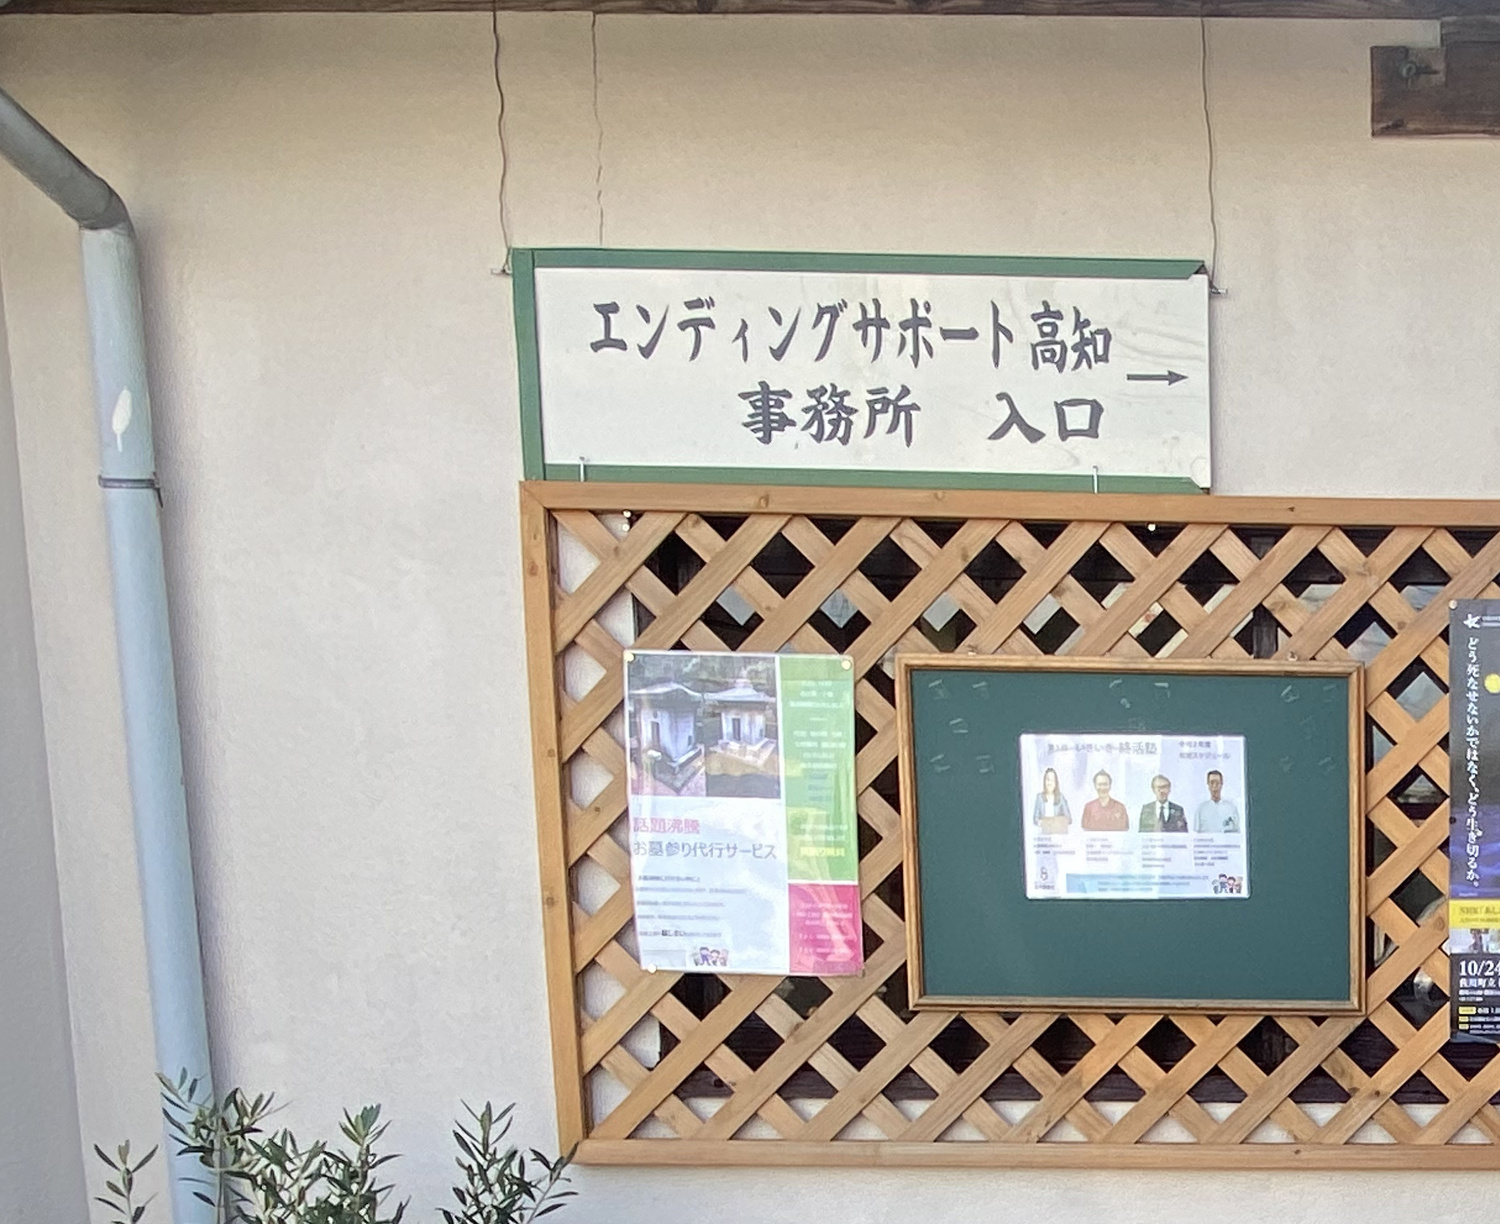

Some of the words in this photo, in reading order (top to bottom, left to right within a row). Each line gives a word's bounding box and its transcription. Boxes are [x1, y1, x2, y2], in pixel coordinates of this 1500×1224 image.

[589, 296, 1112, 373] エンディングサポート高知
[737, 381, 921, 447] 事務所
[987, 392, 1104, 444] 入口
[633, 841, 777, 859] お墓参り代行サービス
